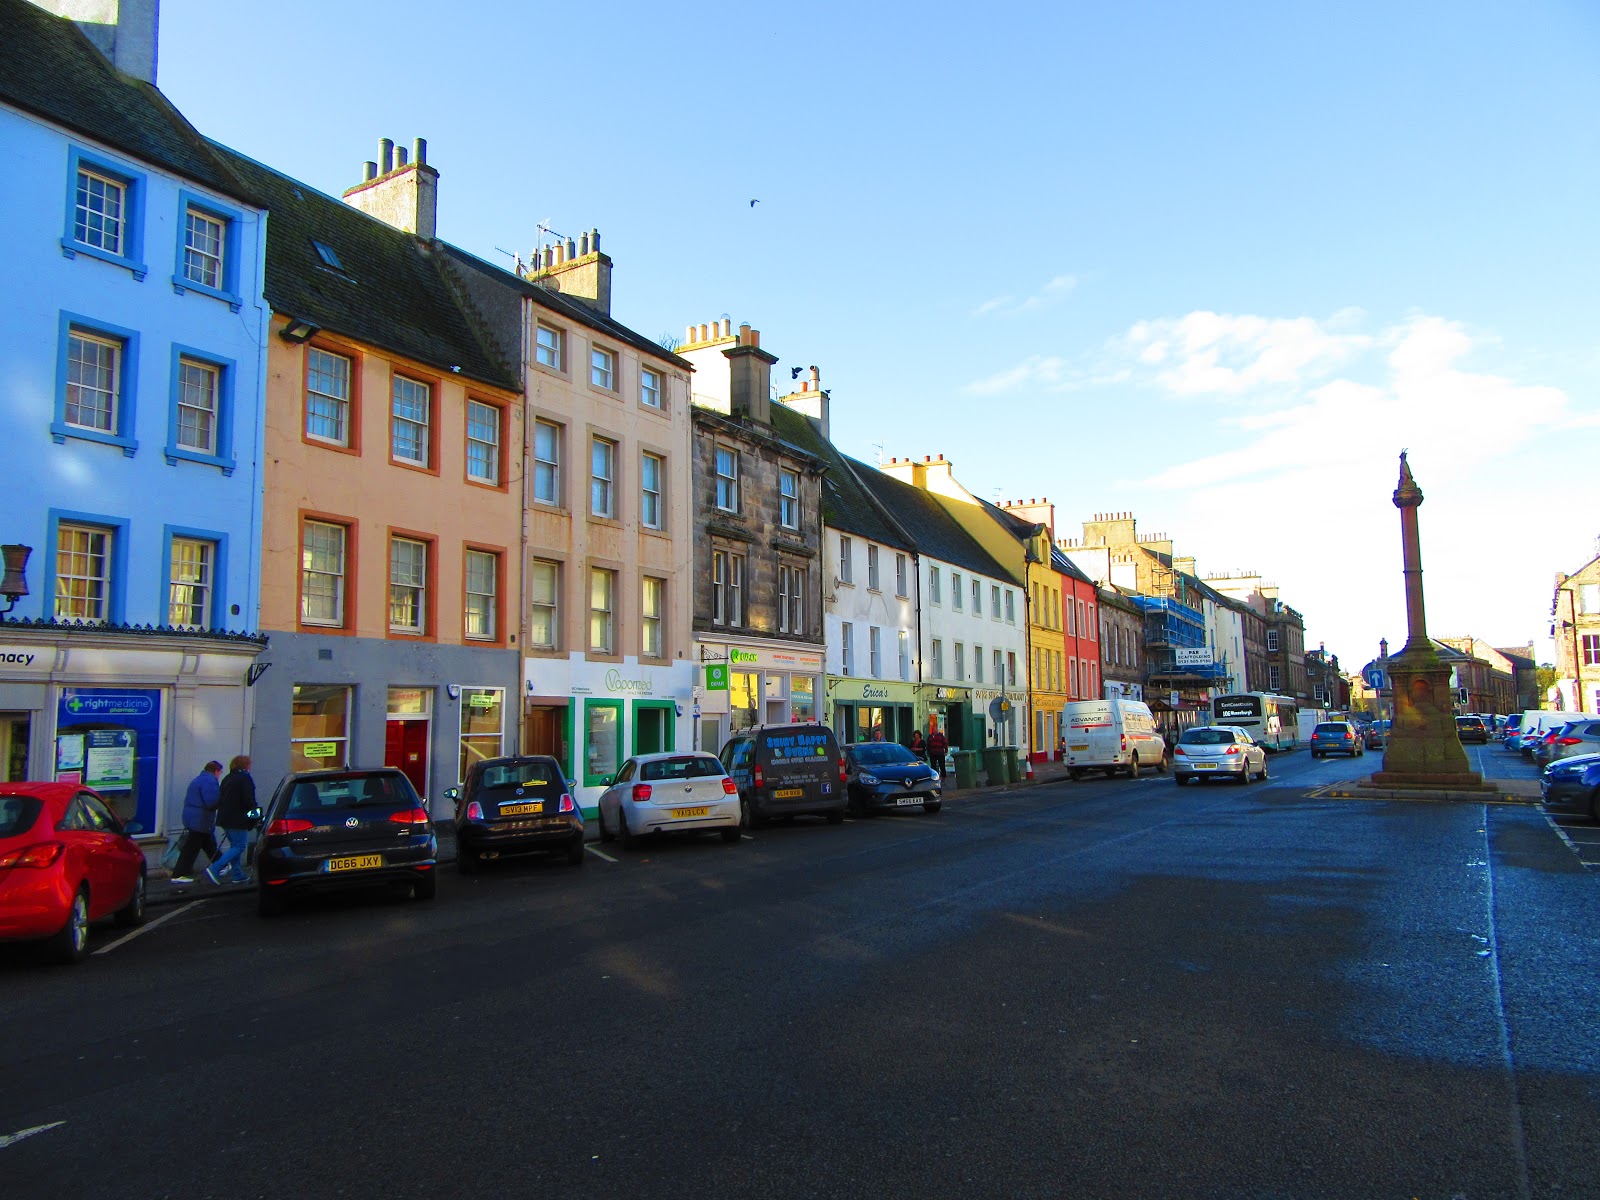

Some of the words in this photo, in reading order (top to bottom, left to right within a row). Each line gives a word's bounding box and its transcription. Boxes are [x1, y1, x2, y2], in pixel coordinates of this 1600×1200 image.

[863, 684, 888, 698] Erica's
[523, 804, 538, 812] MPF
[330, 858, 357, 870] DC66
[360, 856, 379, 867] JXY
